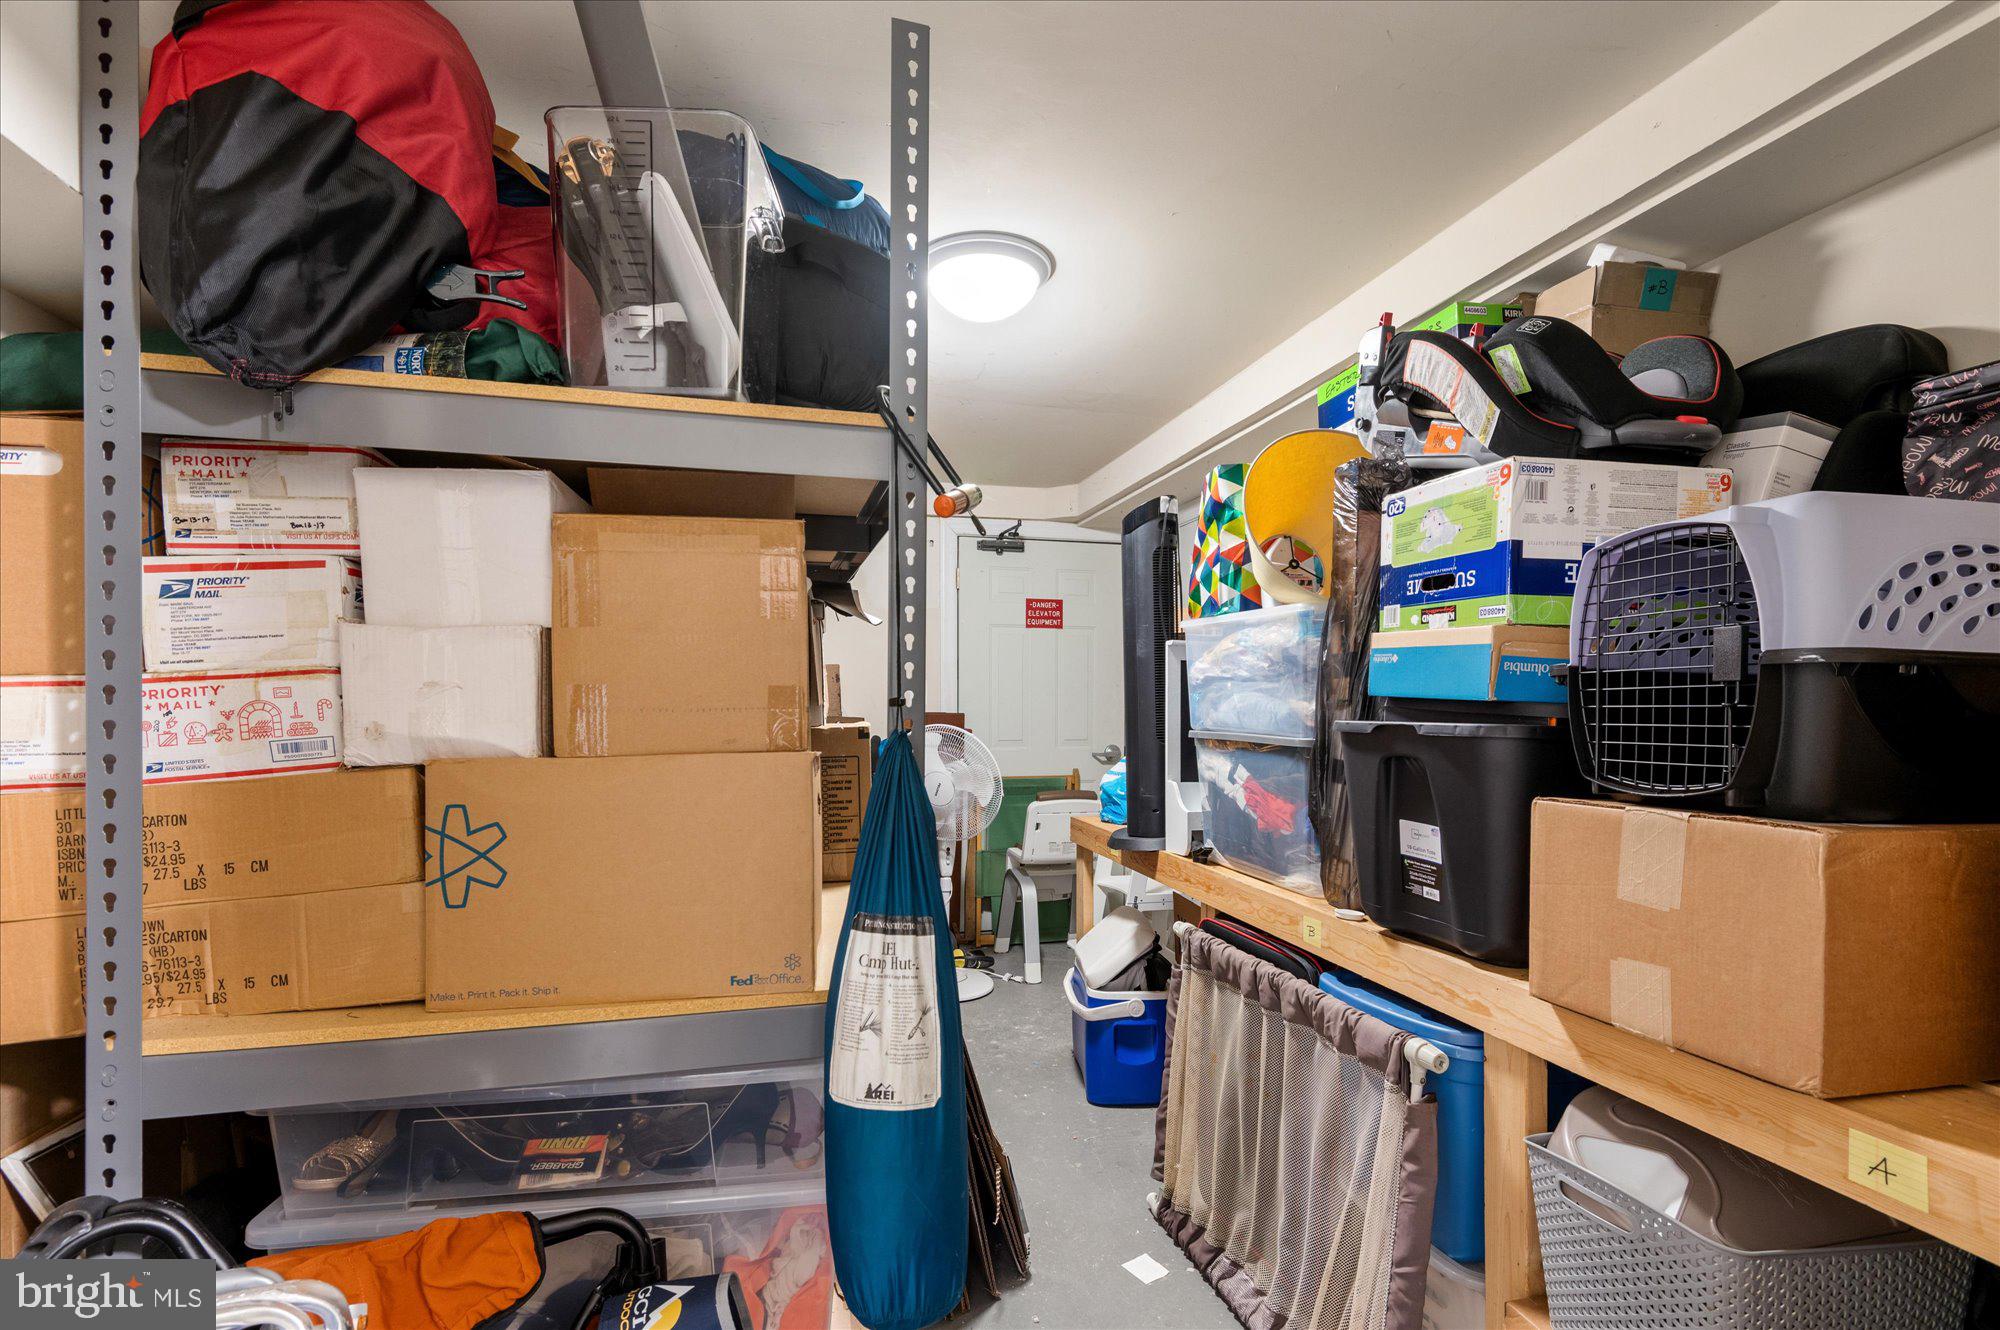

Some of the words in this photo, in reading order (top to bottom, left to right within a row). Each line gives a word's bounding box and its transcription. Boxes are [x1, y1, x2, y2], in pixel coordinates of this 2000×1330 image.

[1647, 280, 1668, 295] #B
[1726, 440, 1751, 450] Classic
[172, 455, 252, 468] PRIORITY
[191, 470, 234, 479] MAIL
[1520, 464, 1554, 474] 4408803
[197, 576, 246, 586] PRIORITY
[194, 590, 222, 599] MAIL
[1027, 618, 1061, 626] EQUIPMENT
[158, 700, 202, 711] MAIL
[56, 821, 72, 834] 30
[143, 853, 186, 868] $24.95
[153, 866, 180, 881] 27.5
[197, 864, 205, 877] X
[223, 862, 235, 875] 15
[250, 859, 269, 873] CM
[184, 878, 207, 891] LBS
[1306, 925, 1316, 937] B
[148, 945, 176, 958] (HB)
[155, 984, 162, 996] X
[177, 981, 202, 995] 27.5
[217, 978, 226, 991] X
[244, 976, 255, 989] 15
[270, 973, 289, 987] CM
[430, 993, 455, 1002] Make
[457, 992, 465, 1001] it.
[467, 990, 487, 999] Print
[489, 990, 497, 998] it.
[499, 989, 520, 997] Pack
[531, 986, 551, 996] Ship
[552, 986, 560, 994] it.
[147, 996, 174, 1010] 29.7
[204, 992, 227, 1005] LBS
[874, 1090, 894, 1100] REI
[1867, 1156, 1897, 1185] A
[632, 1285, 653, 1329] GCI
